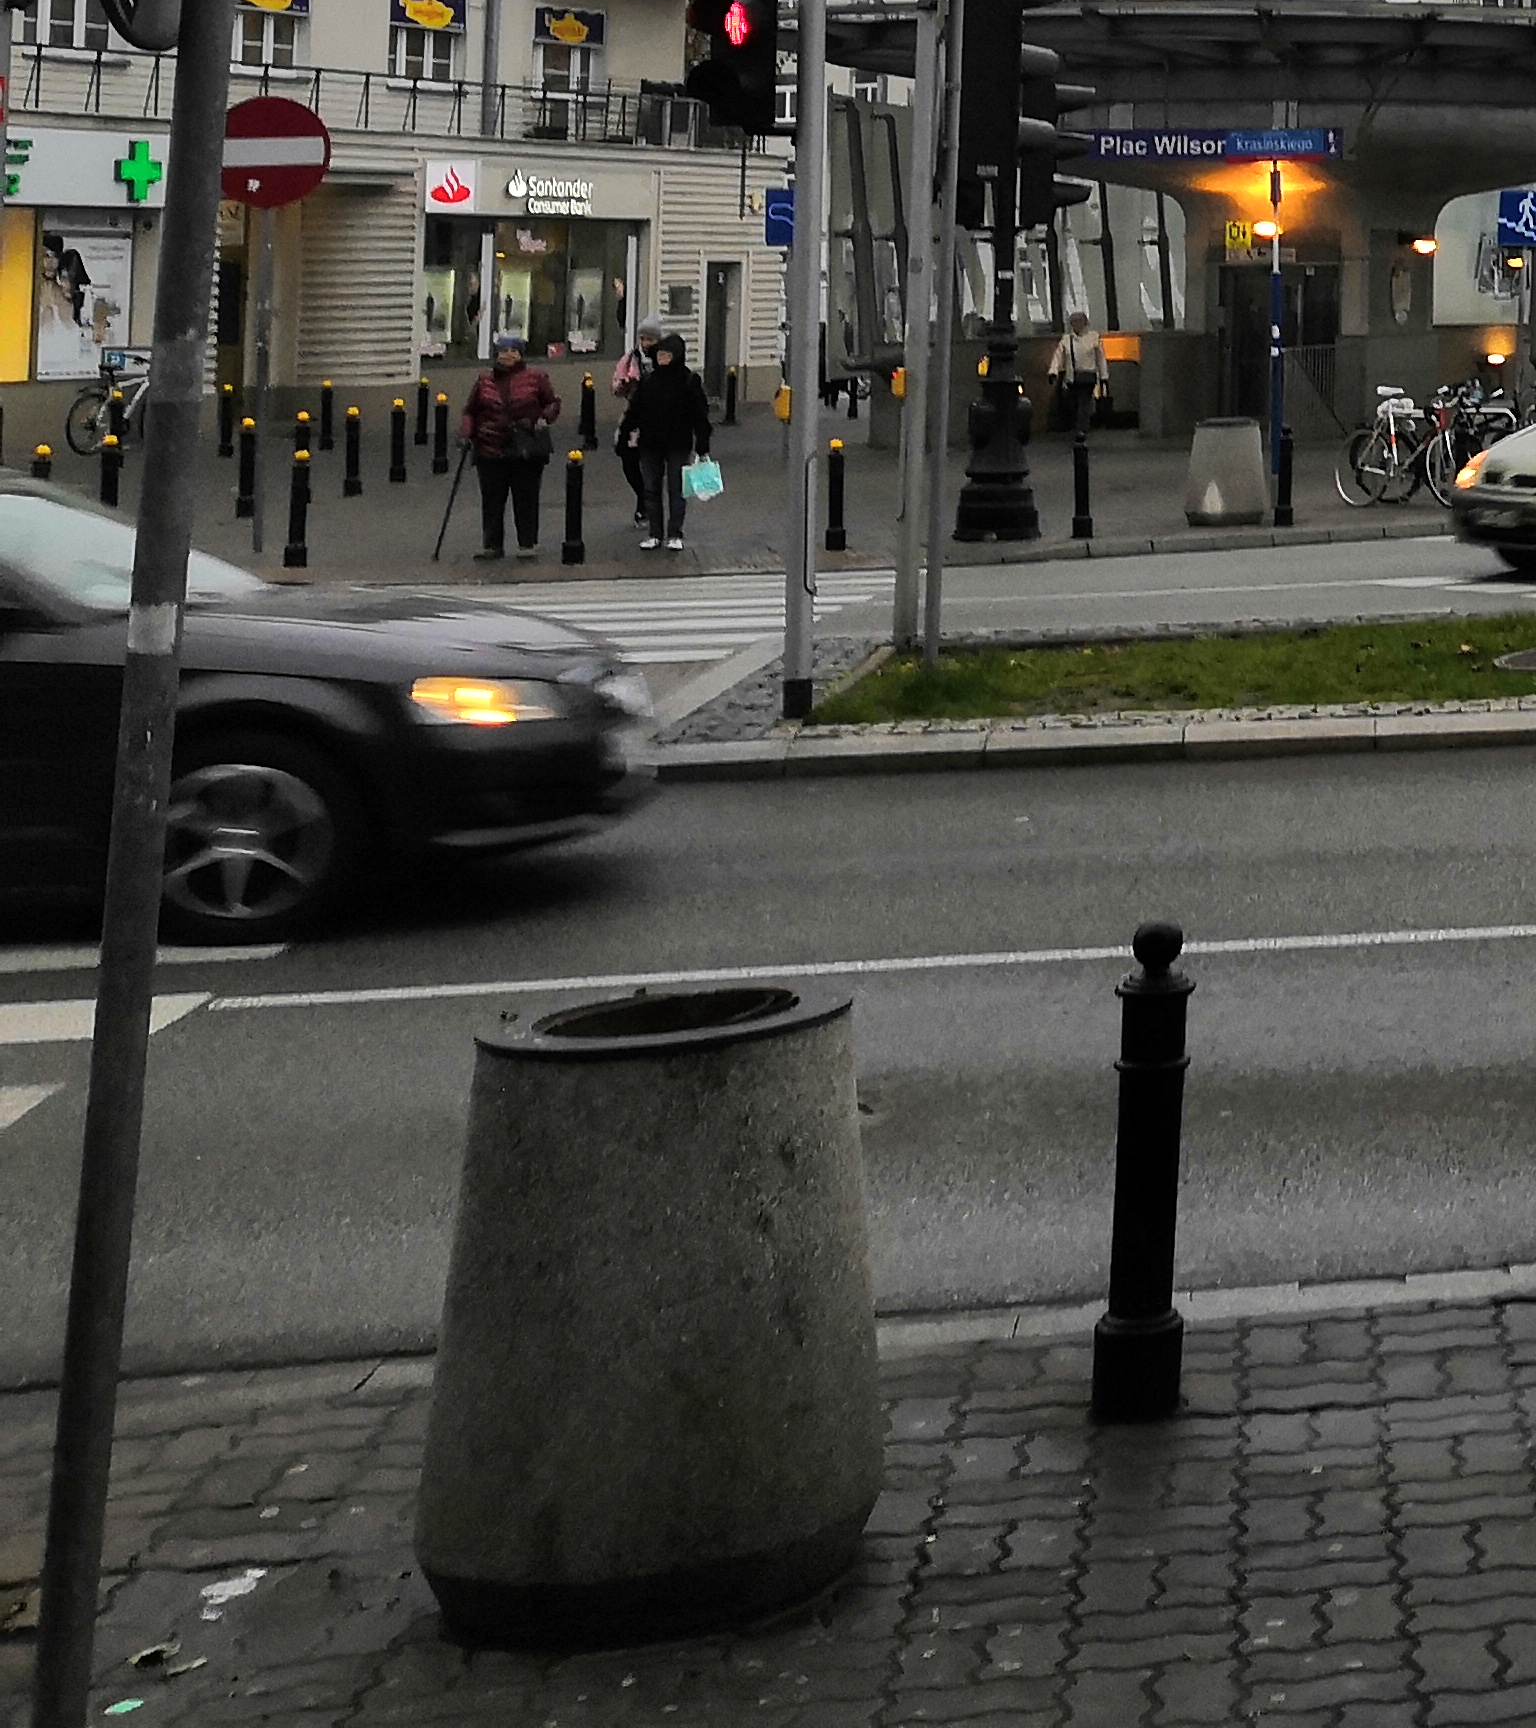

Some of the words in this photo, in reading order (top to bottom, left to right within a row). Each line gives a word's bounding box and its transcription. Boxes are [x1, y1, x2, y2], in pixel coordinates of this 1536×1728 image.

[1100, 135, 1148, 155] Plac
[528, 175, 594, 199] Santander
[527, 197, 569, 215] Consumer
[570, 198, 592, 216] Bank
